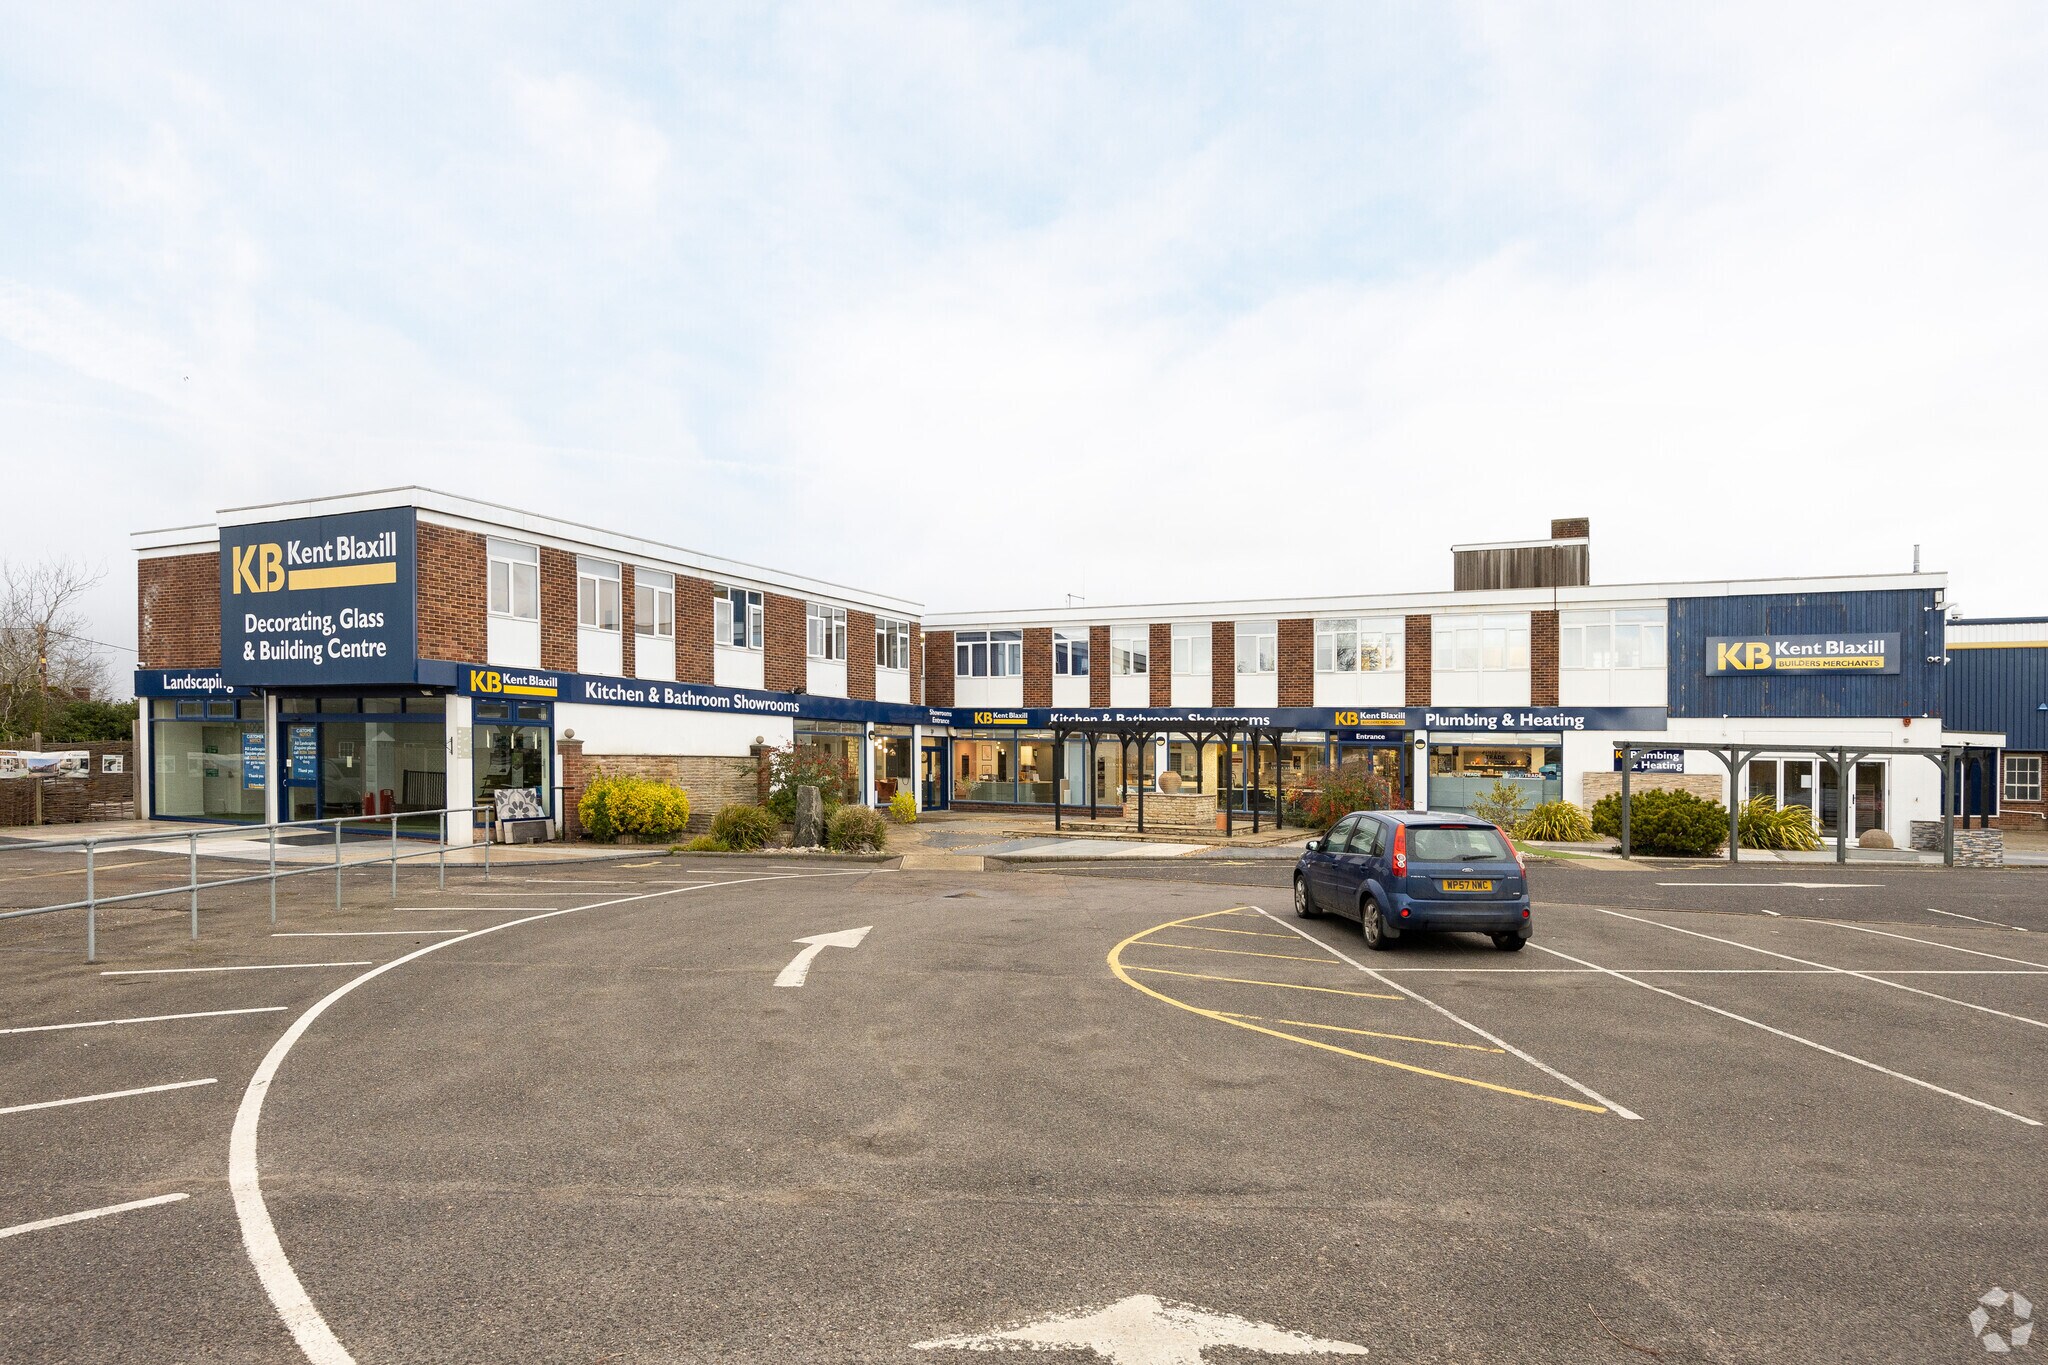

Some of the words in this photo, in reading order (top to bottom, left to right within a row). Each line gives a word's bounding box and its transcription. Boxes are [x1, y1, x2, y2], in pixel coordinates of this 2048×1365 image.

[287, 540, 333, 565] Kent
[336, 531, 397, 561] Blaxill
[232, 543, 285, 594] KB
[245, 610, 336, 636] Decorating,
[339, 608, 384, 629] Glass
[243, 641, 255, 661] &
[259, 639, 323, 665] Building
[327, 637, 387, 659] Centre
[1775, 641, 1822, 656] Kent
[1826, 640, 1885, 655] Blaxill
[1717, 642, 1773, 670] KB
[1779, 659, 1821, 667] BUILDERS
[1823, 659, 1880, 667] MERCHANTS
[470, 669, 502, 693] KB
[503, 673, 528, 686] Kent
[529, 675, 558, 687] Blaxill
[585, 681, 644, 701] Kitchen
[648, 687, 659, 703] &
[664, 688, 730, 708] Bathroom
[734, 693, 800, 713] Showrooms
[929, 708, 952, 717] Showrooms
[932, 716, 950, 724] Entrance
[974, 712, 993, 724] KB
[1050, 714, 1098, 722] Kitchen
[1335, 711, 1359, 726] KB
[1425, 713, 1498, 730] Plumbing
[1501, 713, 1515, 726] &
[1520, 713, 1584, 730] Heating
[1630, 750, 1679, 761] Pumbing
[1641, 761, 1683, 772] Heating
[1447, 881, 1470, 889] WP57
[1472, 881, 1488, 889] NWC
